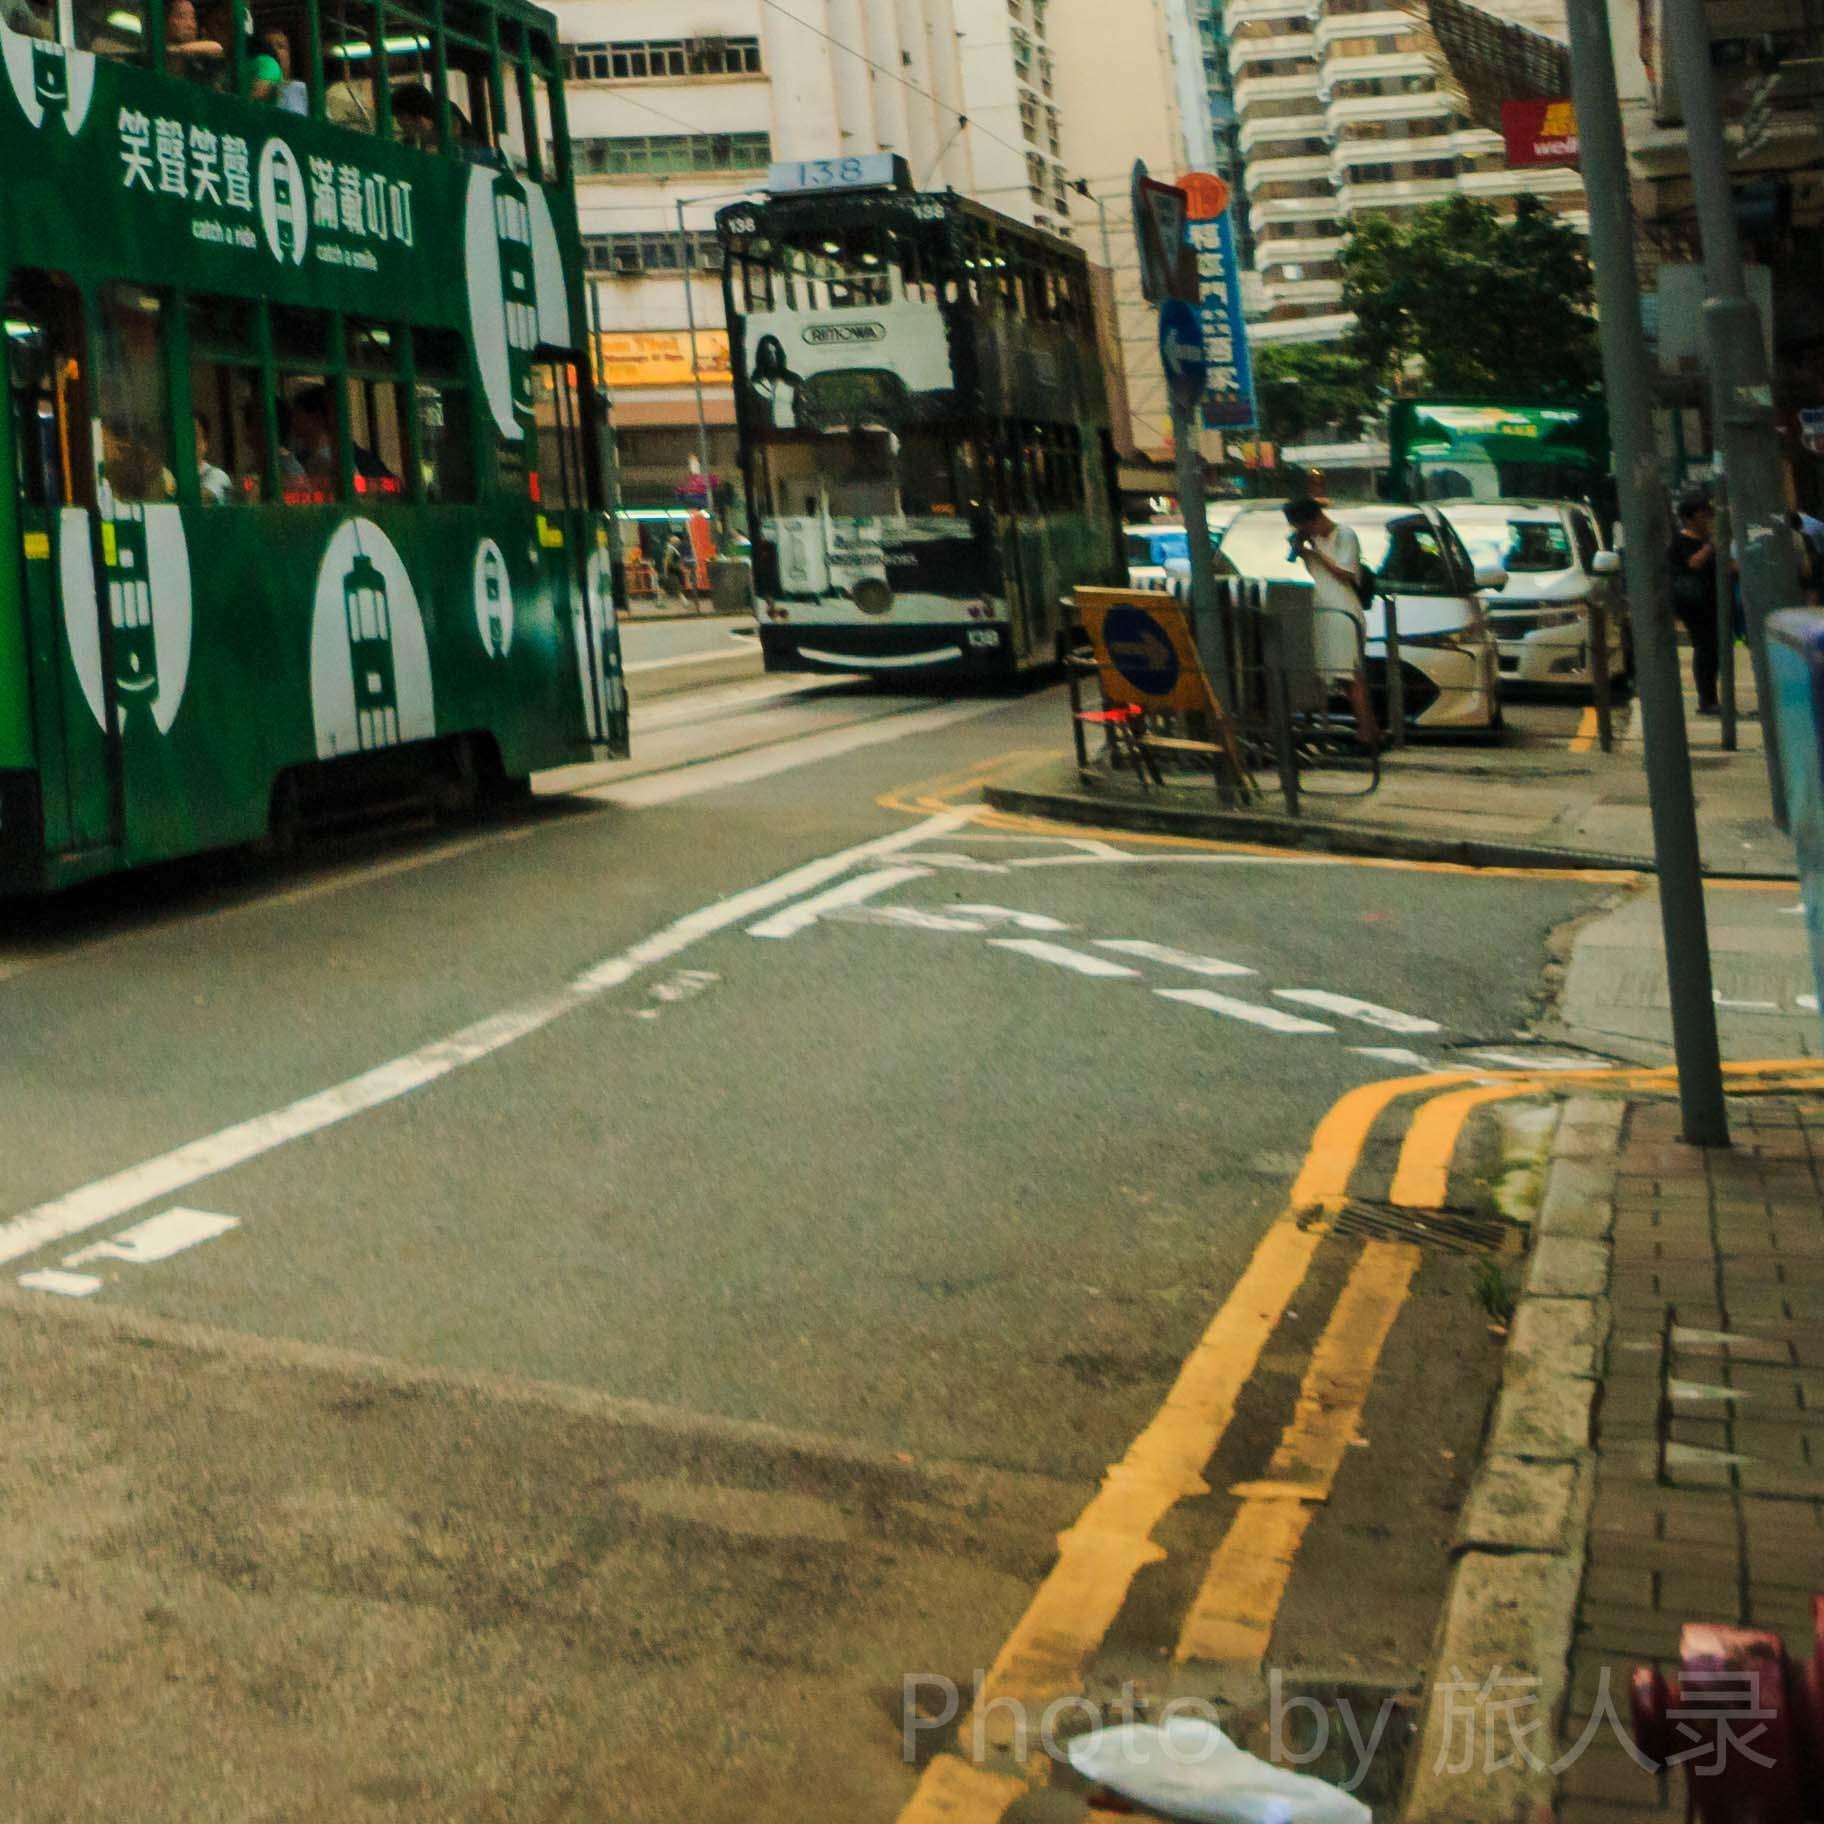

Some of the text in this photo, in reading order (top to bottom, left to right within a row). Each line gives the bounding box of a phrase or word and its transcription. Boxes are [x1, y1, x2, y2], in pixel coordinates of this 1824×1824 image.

[117, 106, 414, 249] 笑聲笑聲 滿載叮叮
[798, 157, 865, 186] 138
[725, 216, 757, 234] 138
